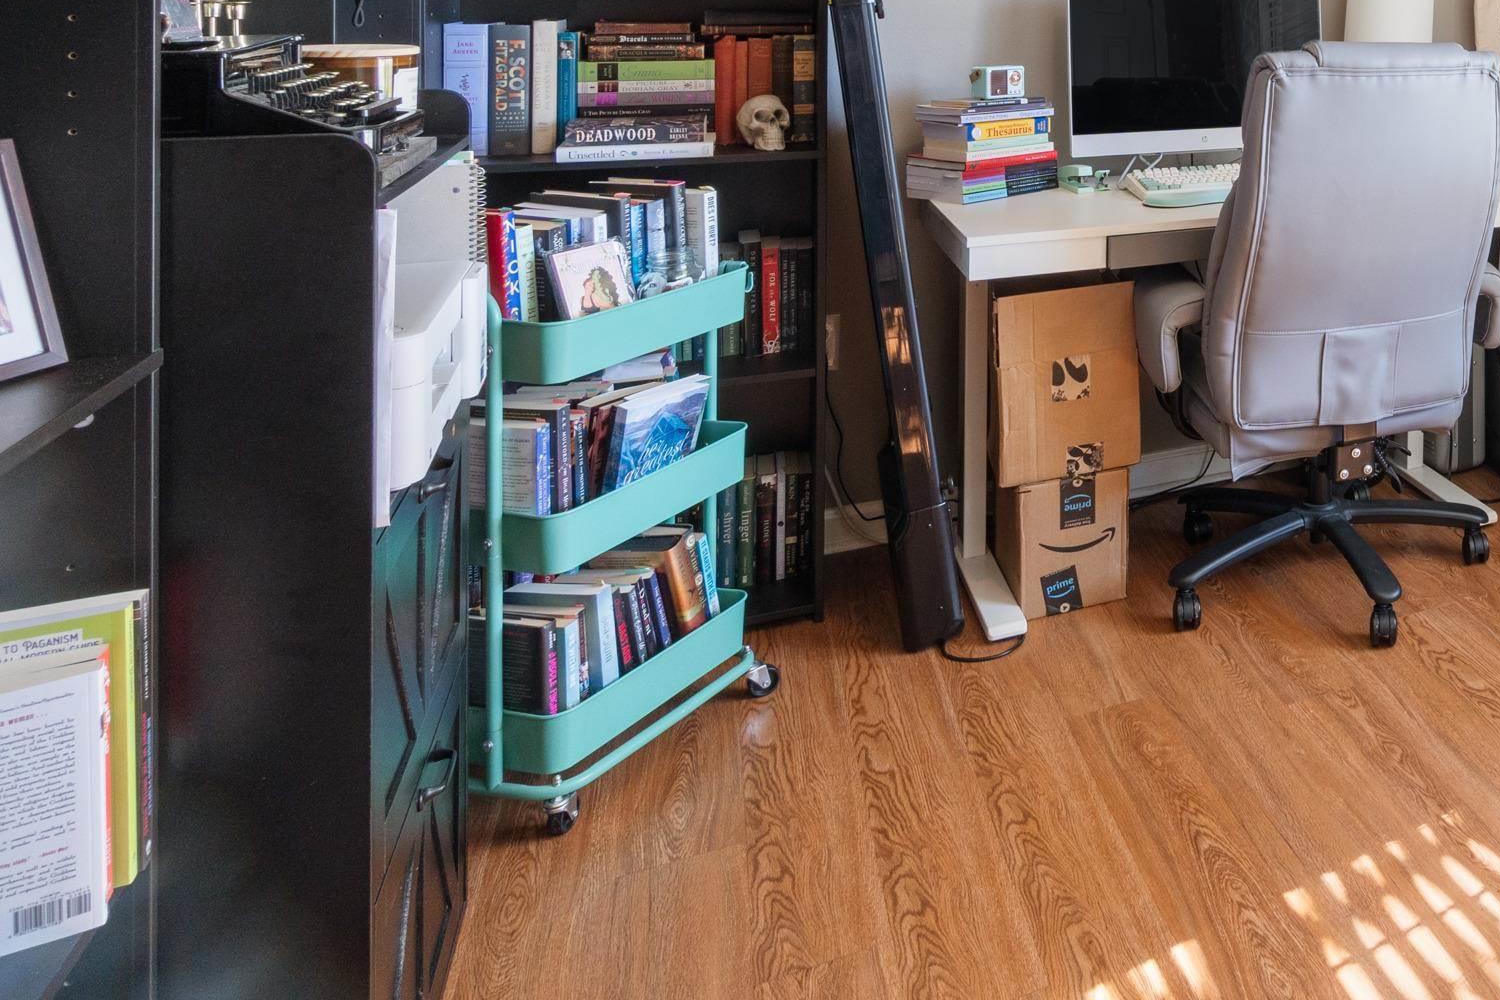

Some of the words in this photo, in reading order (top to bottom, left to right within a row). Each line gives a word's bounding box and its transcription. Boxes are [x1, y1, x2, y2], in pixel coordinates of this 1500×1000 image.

[509, 39, 526, 53] F.
[618, 35, 648, 43] Dracula
[495, 39, 508, 111] FITZGERALD
[622, 65, 662, 78] Emma
[509, 56, 526, 110] SCOTT
[575, 127, 657, 143] DEADWOOD
[985, 125, 1034, 138] Thesaurus
[568, 148, 615, 160] Unsettled
[707, 196, 715, 214] DOES
[708, 225, 716, 247] HURT?
[1064, 498, 1092, 512] prime
[722, 512, 734, 545] shiver
[738, 509, 752, 543] linger
[686, 535, 699, 575] Divine
[694, 574, 705, 609] Rivals
[701, 547, 711, 571] STARTS
[706, 572, 714, 589] WITH
[1046, 577, 1074, 595] prime
[638, 586, 651, 635] Decadent
[4, 644, 18, 654] TO
[22, 632, 79, 652] PAGANISM
[617, 622, 632, 665] BASTARD
